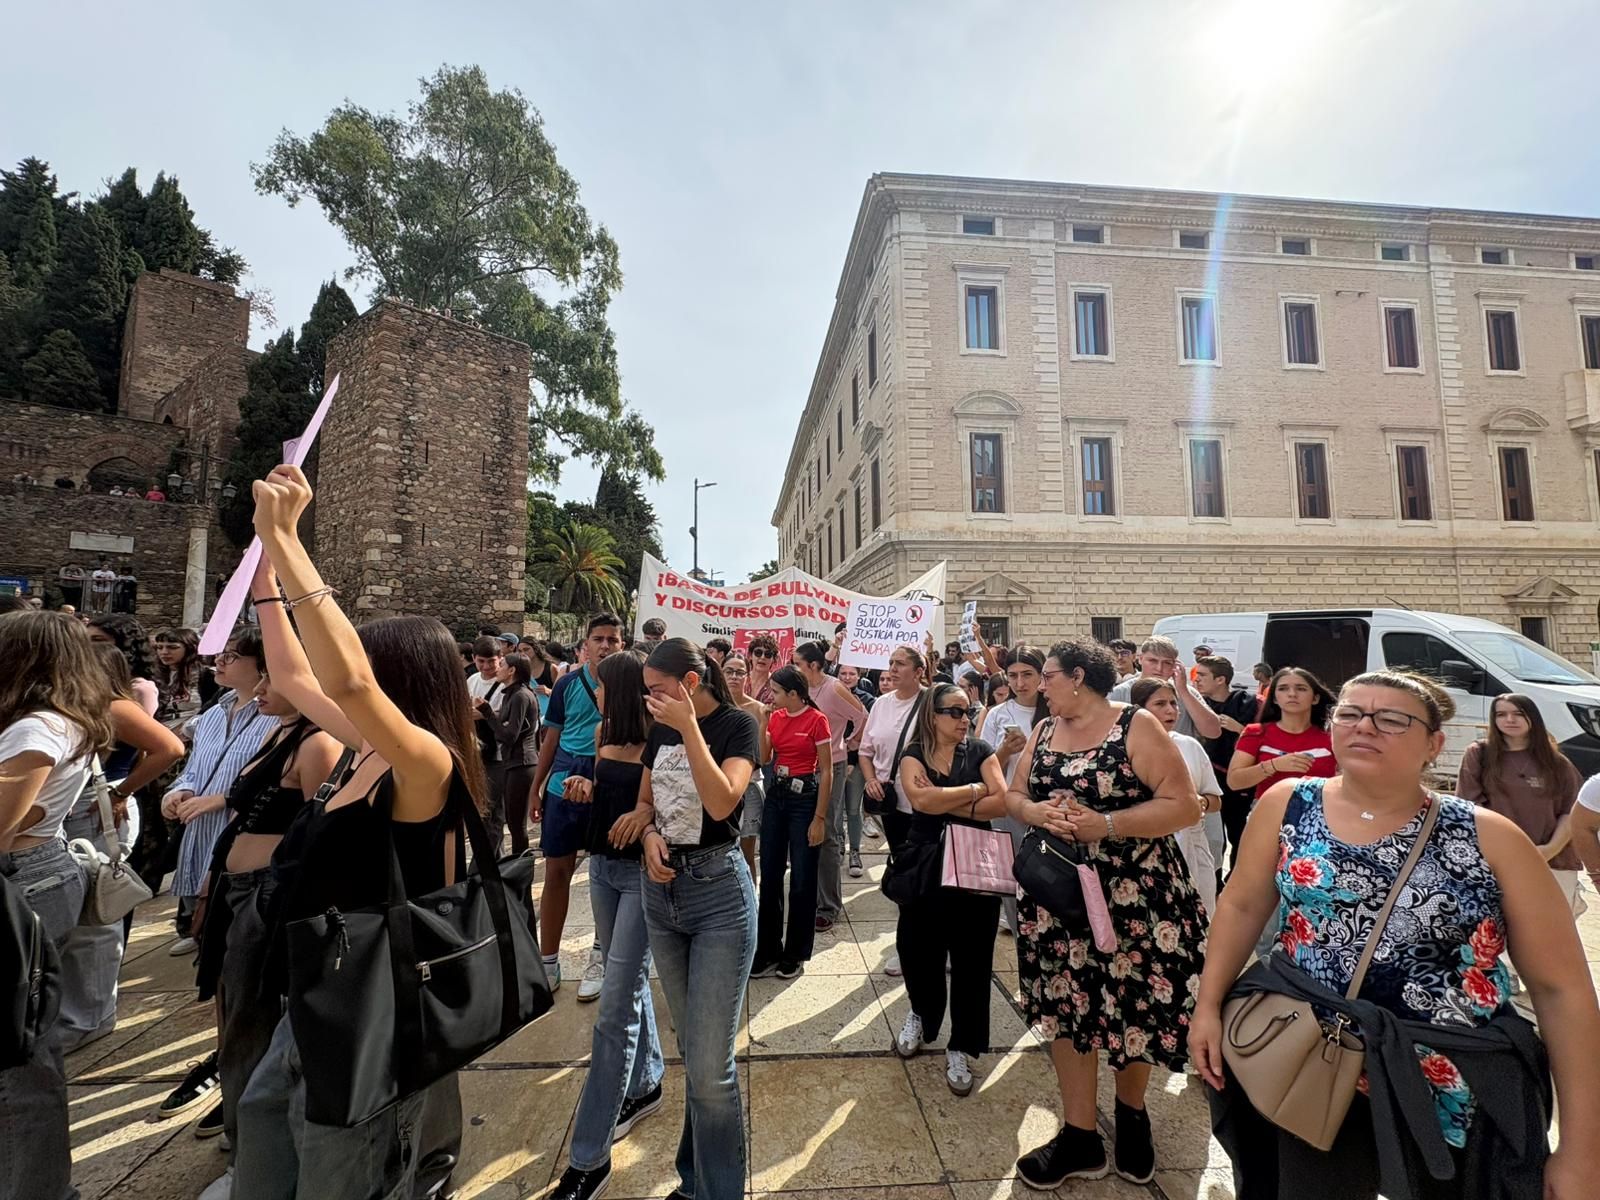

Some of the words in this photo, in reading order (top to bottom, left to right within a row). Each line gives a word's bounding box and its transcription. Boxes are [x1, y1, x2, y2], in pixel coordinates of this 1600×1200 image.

[658, 572, 729, 600] ¡BASTA
[734, 588, 763, 602] DE
[768, 581, 851, 608] BULLYIN
[655, 593, 668, 607] Y
[672, 597, 789, 619] DISCURSOS
[794, 604, 815, 619] DE
[858, 604, 897, 617] STOP
[856, 618, 902, 629] BULLYING
[854, 628, 893, 640] JUSTICIA
[896, 631, 919, 642] POR
[850, 640, 890, 656] SANDRA
